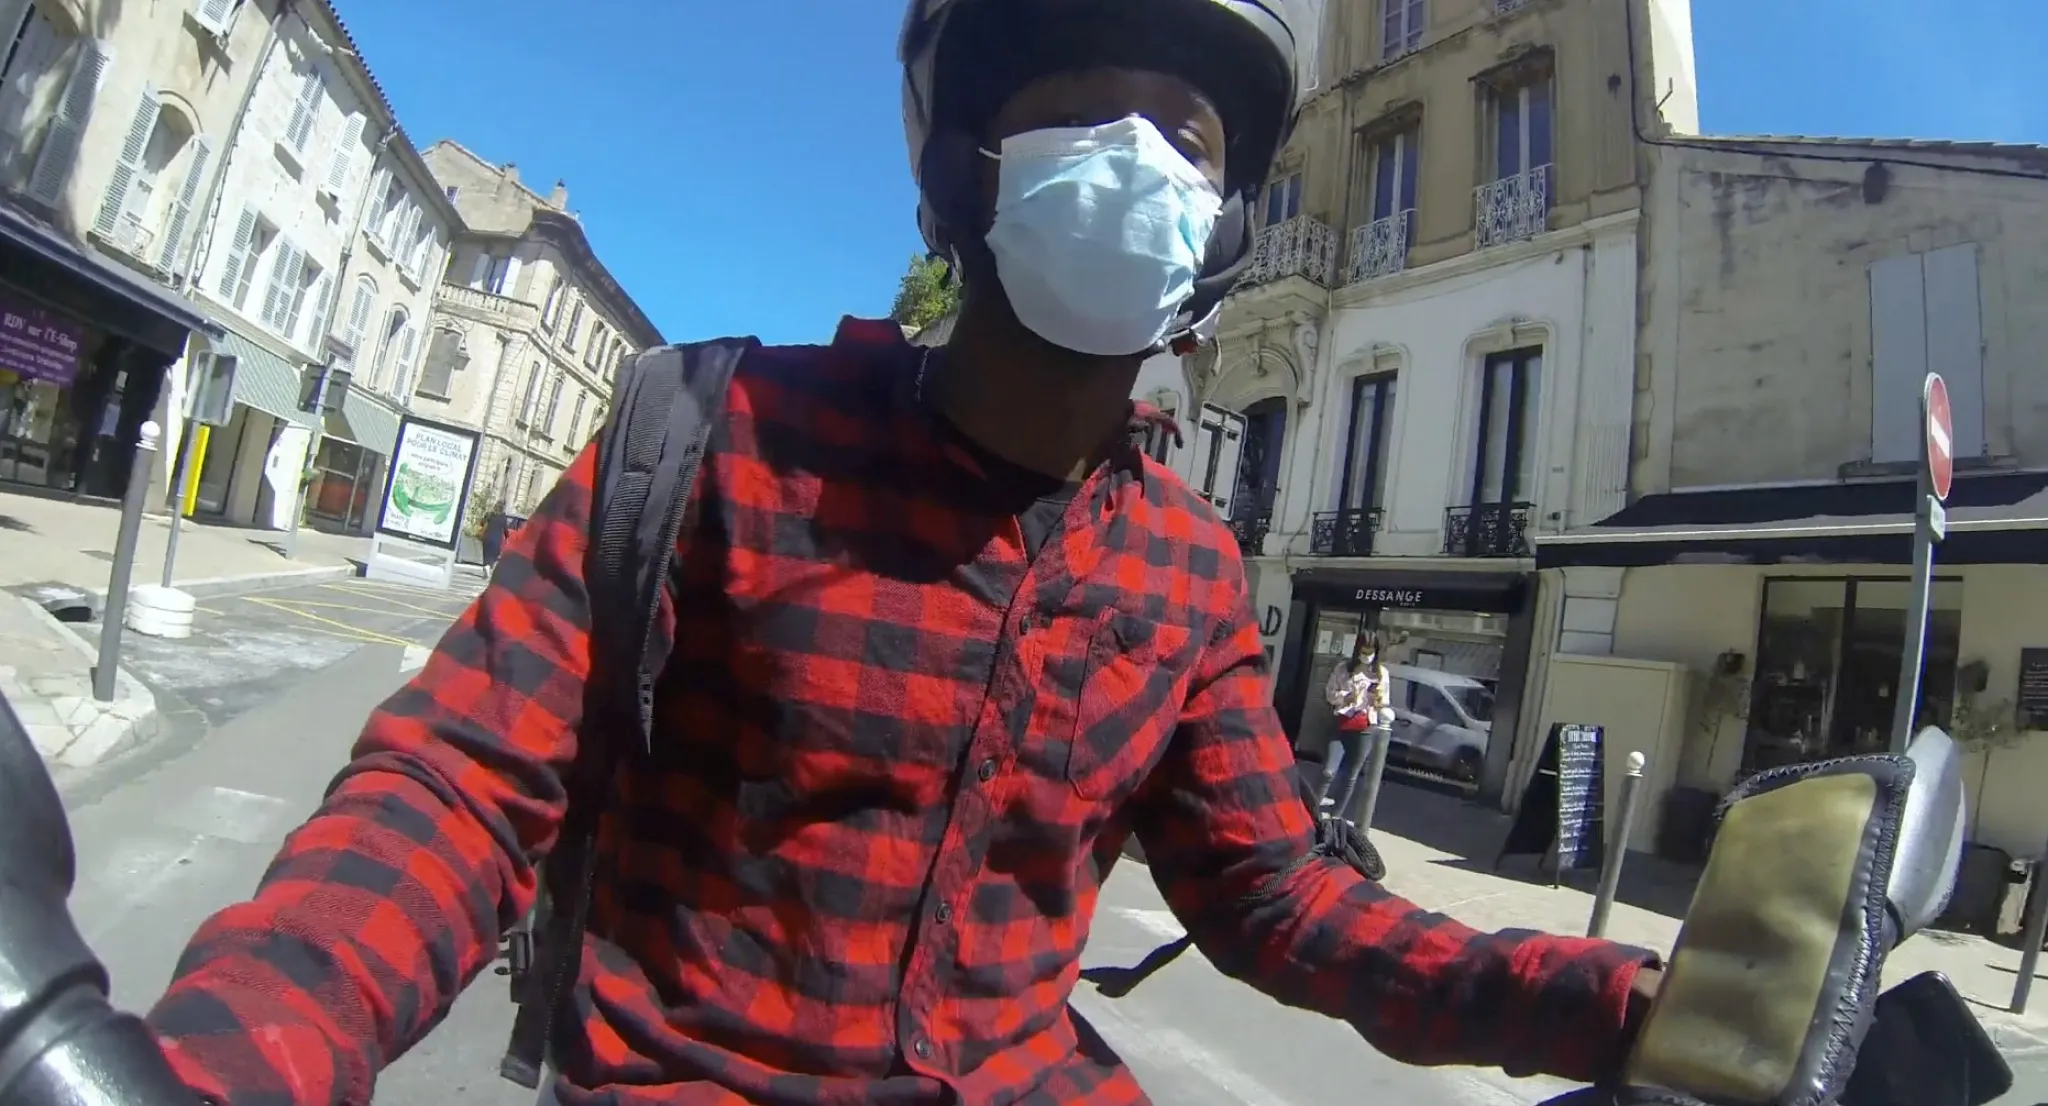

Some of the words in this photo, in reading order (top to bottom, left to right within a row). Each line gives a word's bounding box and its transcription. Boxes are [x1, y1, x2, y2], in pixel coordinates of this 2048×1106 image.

[3, 312, 26, 330] RDV
[406, 437, 427, 450] POUR
[428, 443, 438, 453] LE
[416, 432, 437, 445] PLAN
[437, 439, 462, 453] LOCAL
[1355, 588, 1424, 603] DESSANGE
